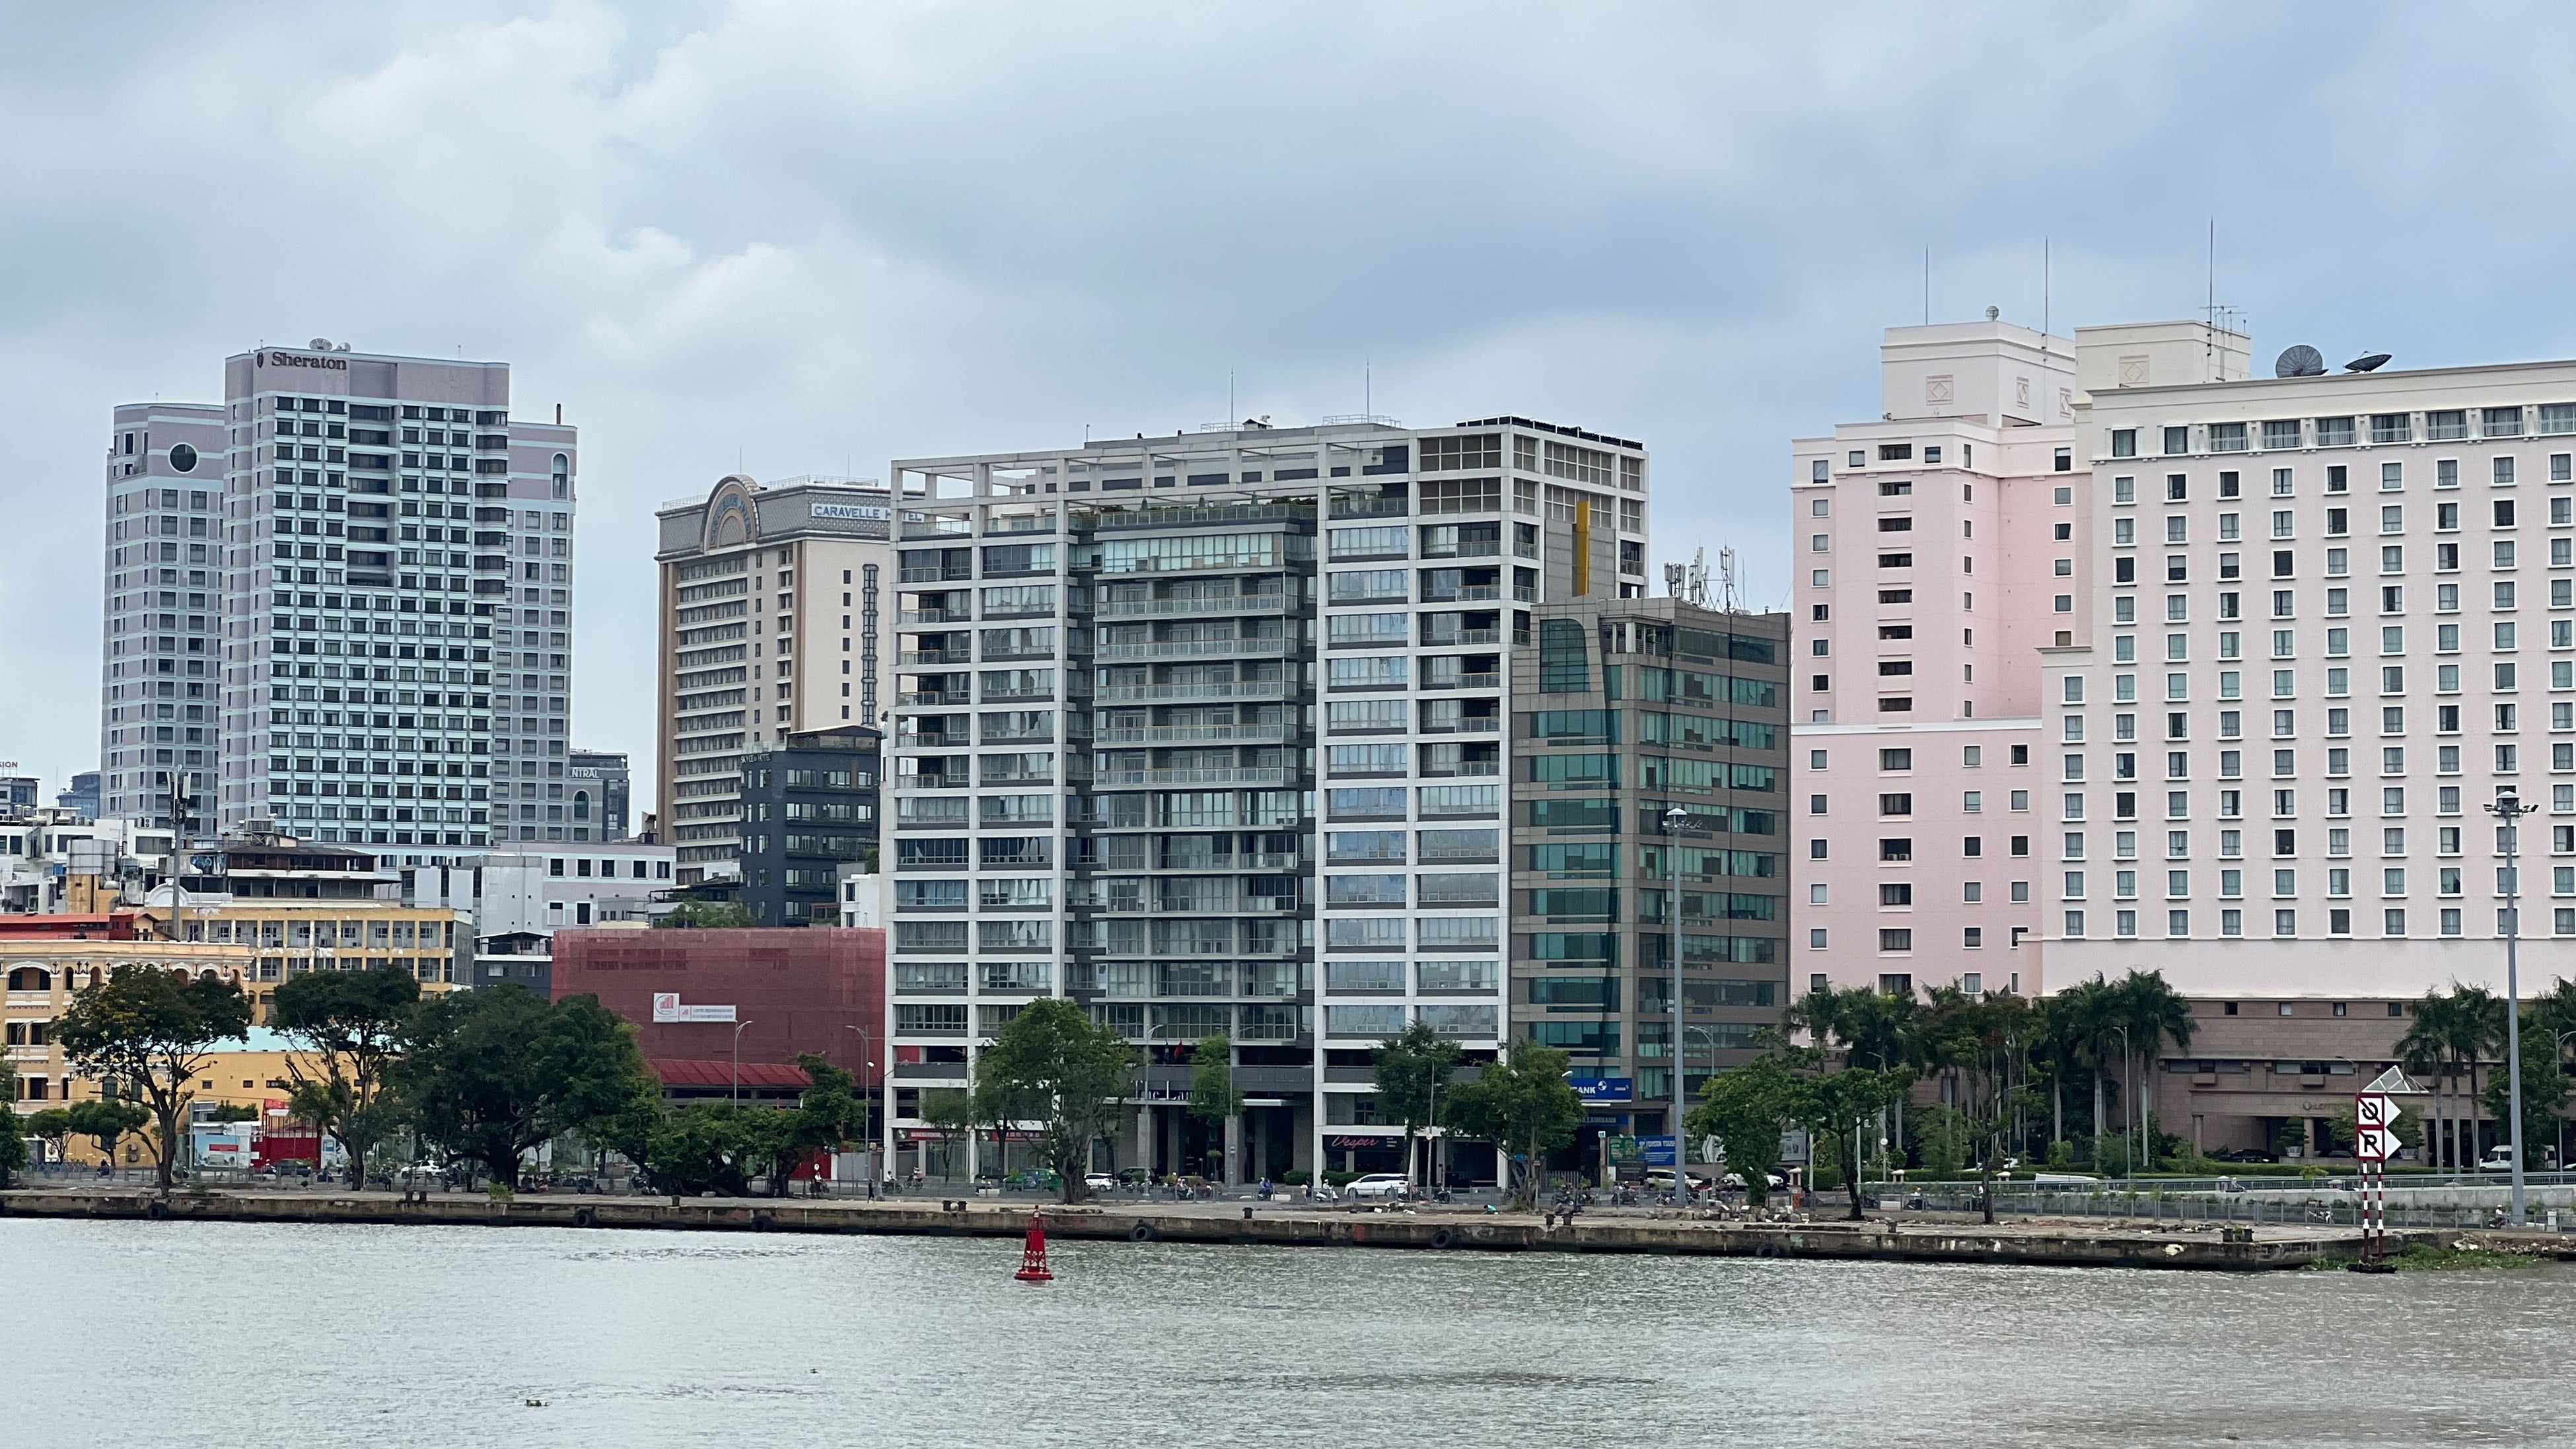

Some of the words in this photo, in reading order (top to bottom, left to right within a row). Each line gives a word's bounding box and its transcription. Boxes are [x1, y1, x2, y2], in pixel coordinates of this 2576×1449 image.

[271, 351, 347, 370] Sheraton
[814, 507, 879, 518] CARAVELLE
[885, 509, 922, 521] HTEL
[571, 769, 600, 778] NTRAL
[1332, 1135, 1379, 1149] Vesper
